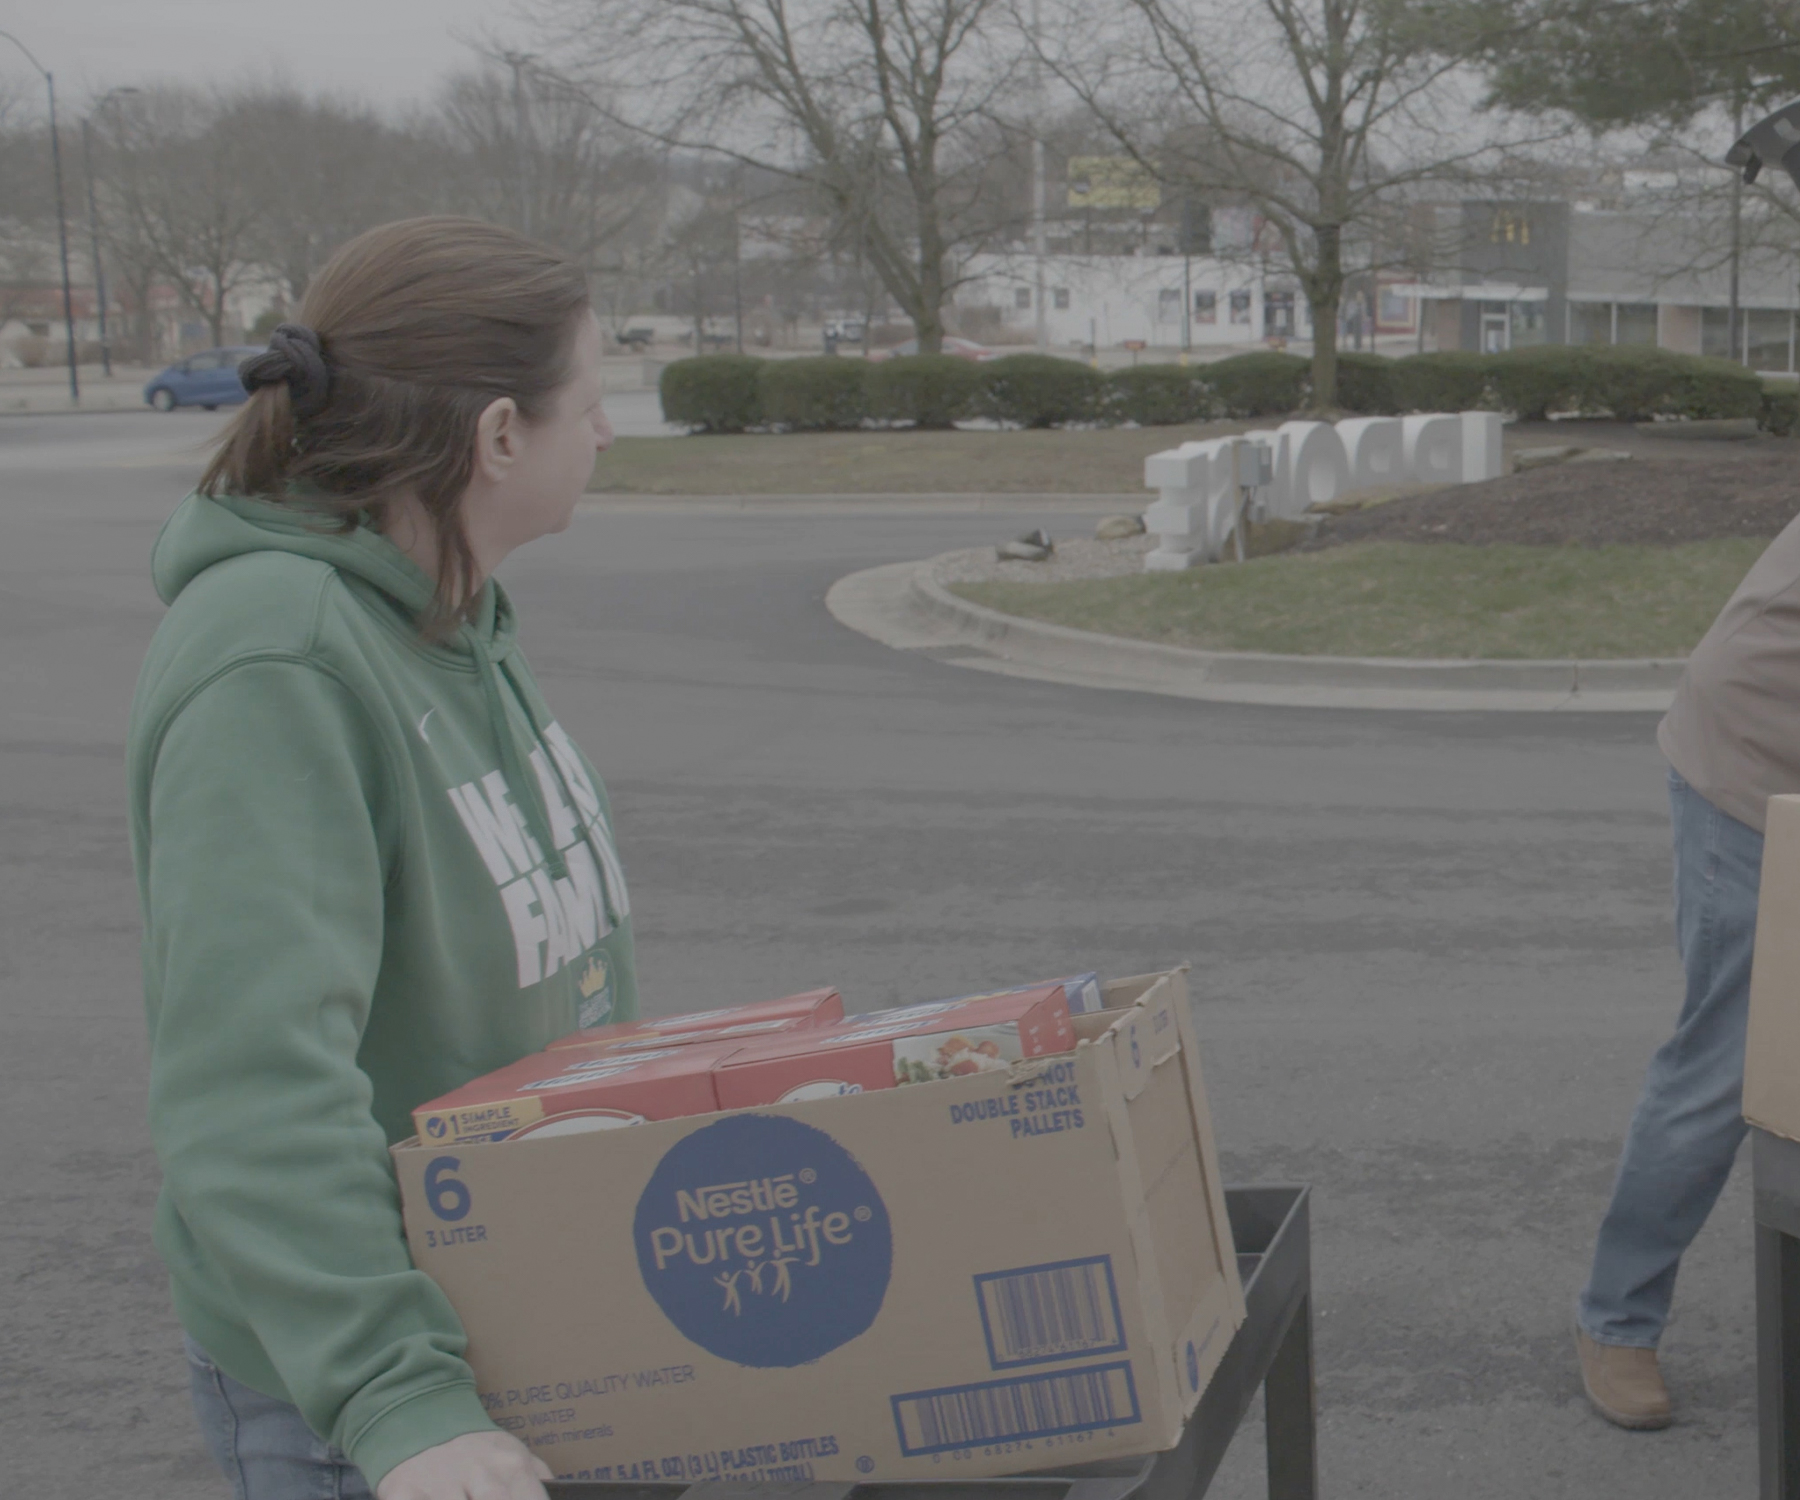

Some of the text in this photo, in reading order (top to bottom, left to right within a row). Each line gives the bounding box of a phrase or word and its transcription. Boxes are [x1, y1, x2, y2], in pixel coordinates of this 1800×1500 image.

[950, 1090, 1020, 1125] DOUBLE
[1026, 1083, 1081, 1112] STACK
[449, 1106, 511, 1135] 1 SIMPLE
[464, 1117, 520, 1133] INGREDIENT
[1009, 1108, 1085, 1139] PALLETS
[423, 1155, 473, 1222] 6
[426, 1224, 488, 1248] 3 LITER
[650, 1205, 854, 1270] Pure Life
[506, 1384, 553, 1406] PURE
[555, 1372, 631, 1400] QUALITY
[635, 1364, 696, 1388] WATER
[528, 1408, 576, 1427] WATER
[535, 1431, 559, 1447] with
[562, 1424, 614, 1442] minerals
[720, 1444, 776, 1471] PLASTIC
[779, 1435, 841, 1462] BOTTLES
